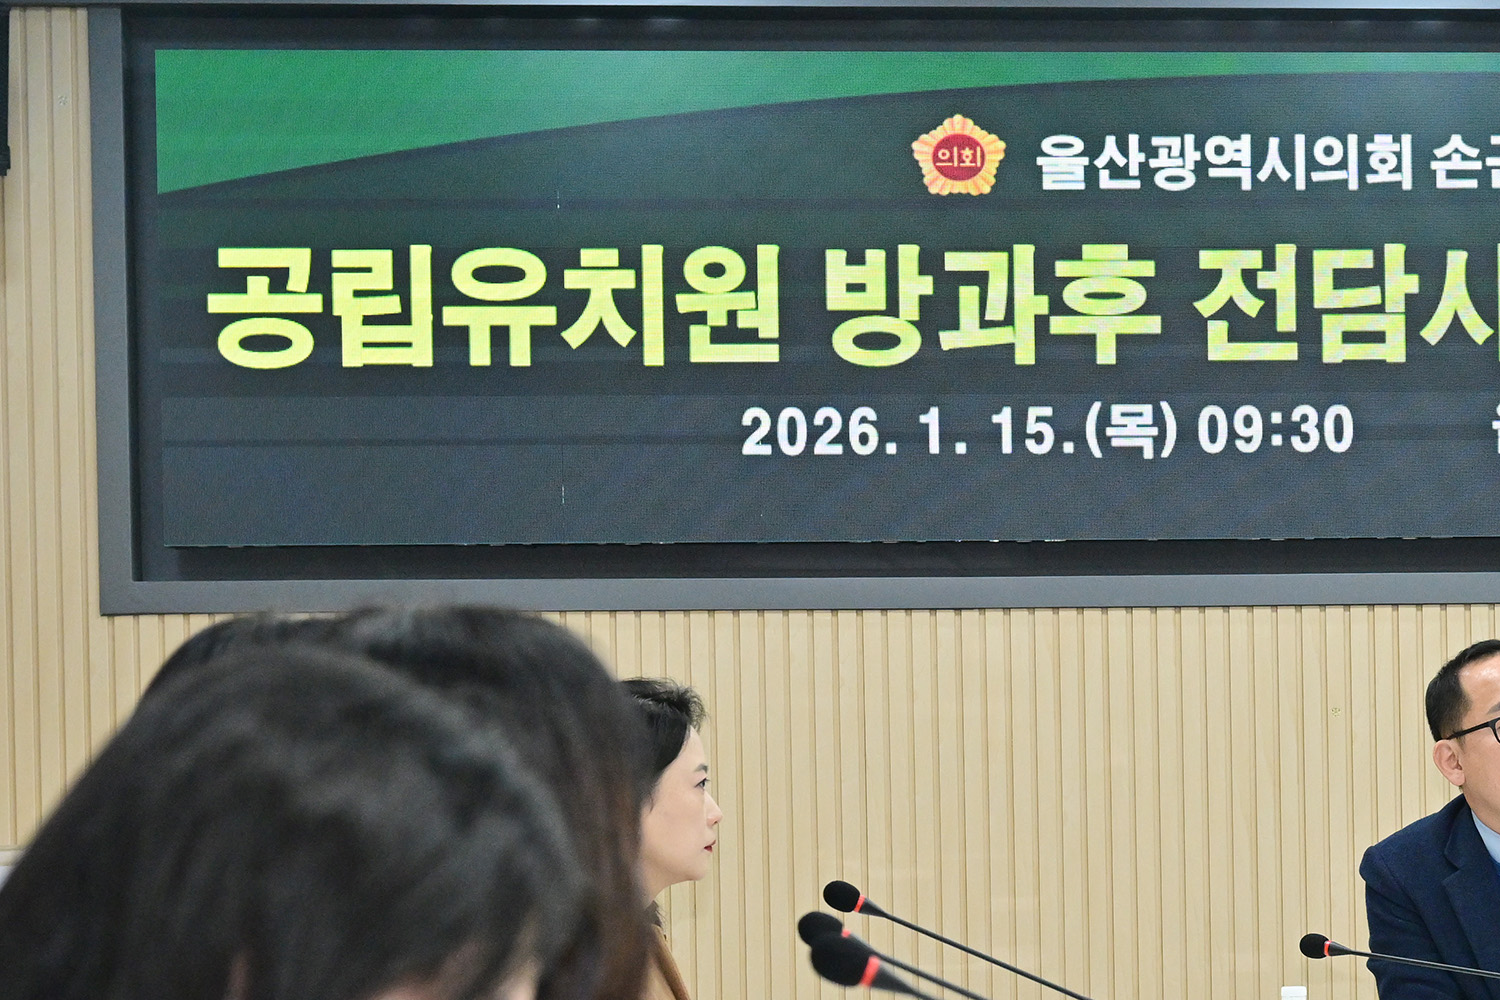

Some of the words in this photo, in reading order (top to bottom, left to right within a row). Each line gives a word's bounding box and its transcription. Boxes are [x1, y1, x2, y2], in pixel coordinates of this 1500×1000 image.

[934, 145, 982, 168] 의회
[1036, 133, 1413, 191] 울산광역시의회
[207, 244, 780, 370] 공립유치원
[825, 243, 1162, 367] 방과후
[741, 405, 897, 456] 2026.
[919, 406, 967, 455] 1.
[991, 401, 1177, 460] 15.(목)
[1198, 404, 1354, 454] 09:30
